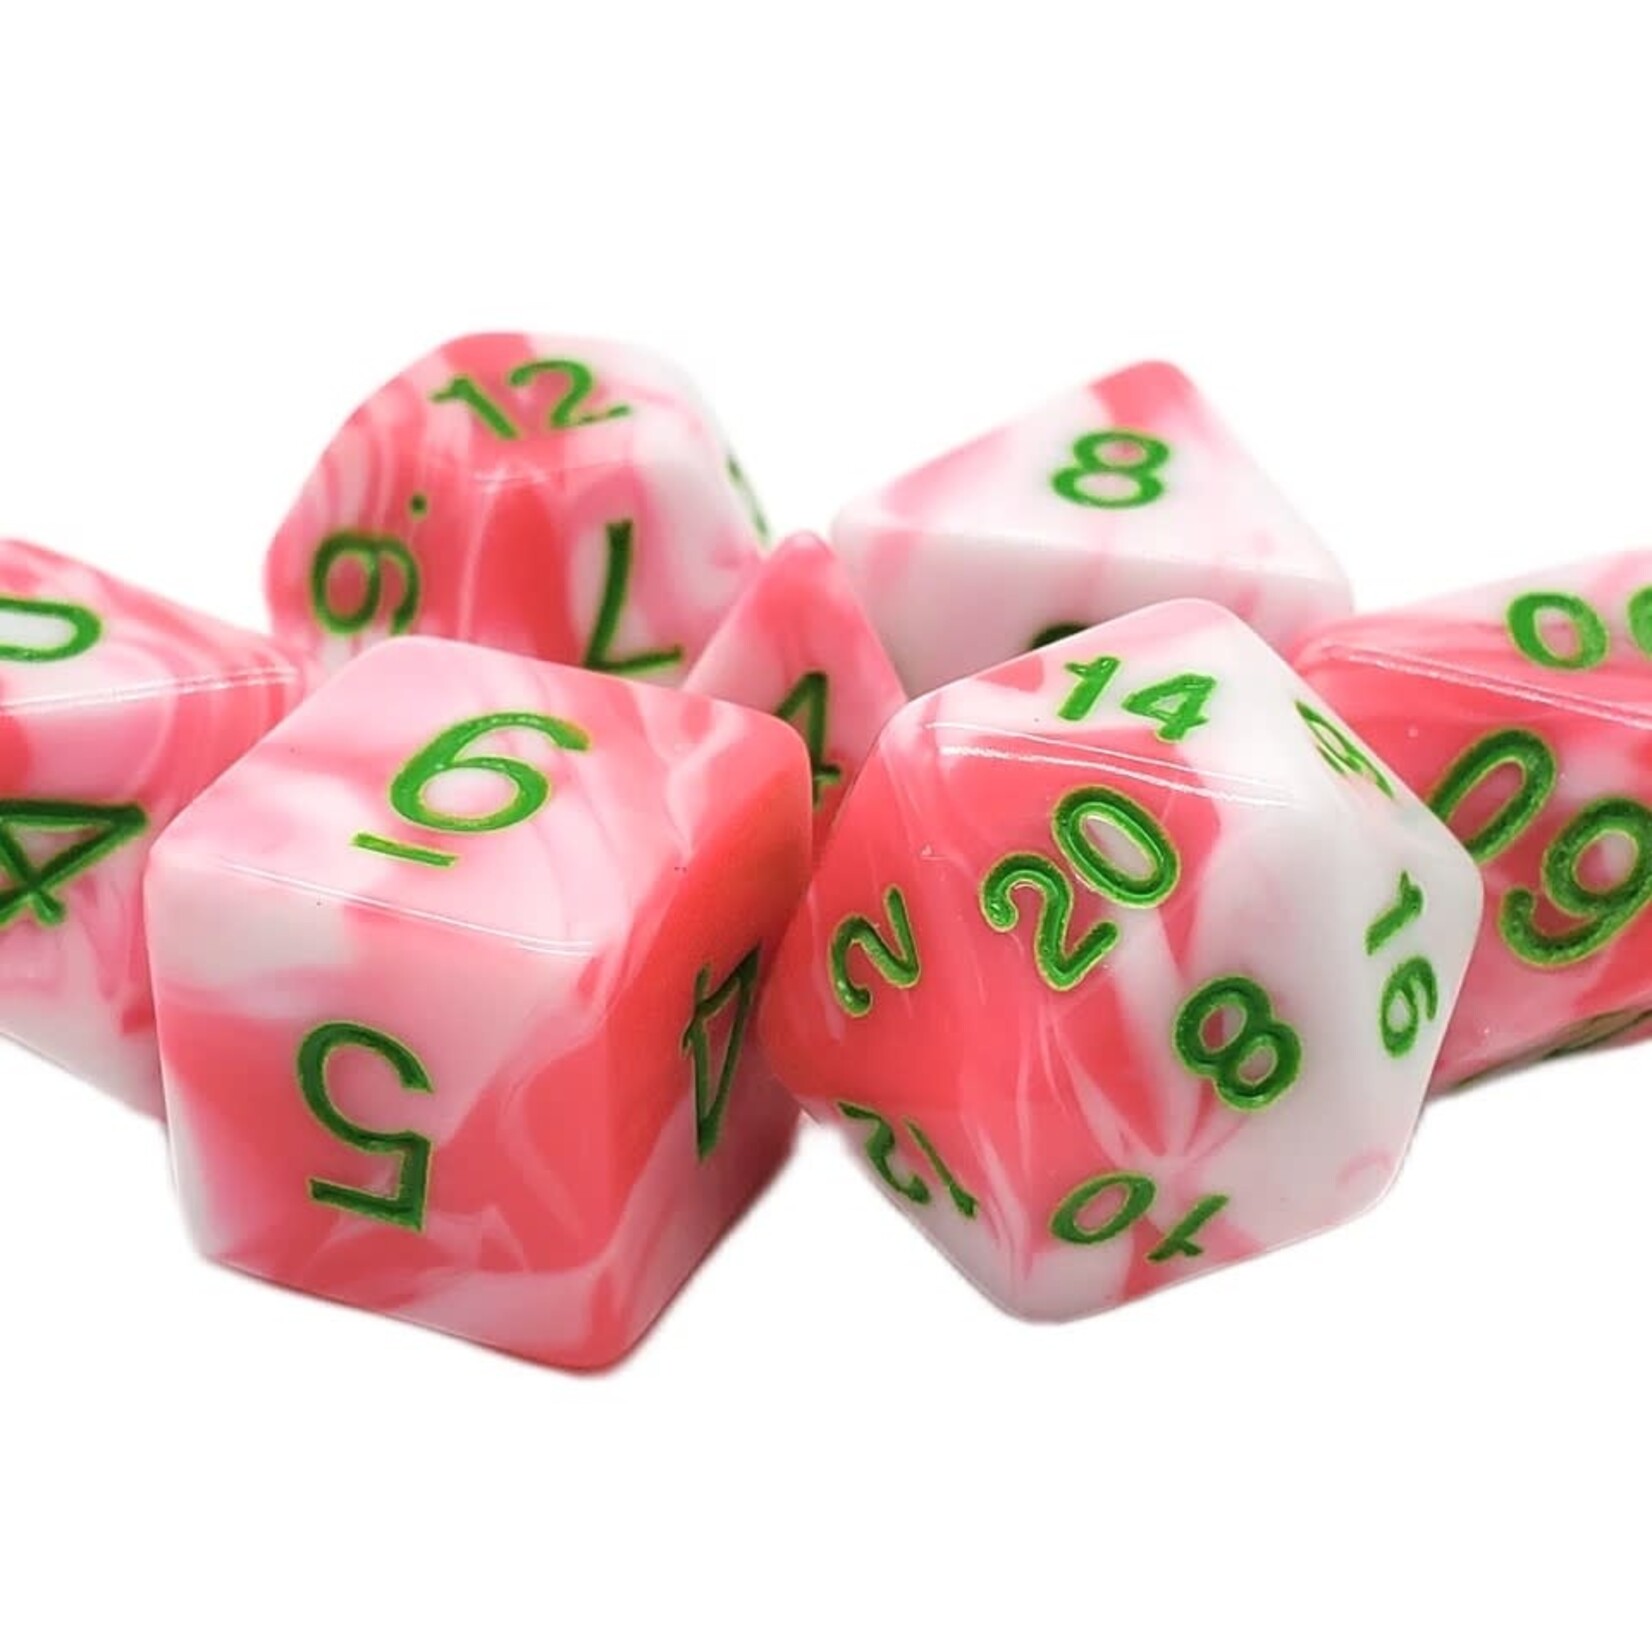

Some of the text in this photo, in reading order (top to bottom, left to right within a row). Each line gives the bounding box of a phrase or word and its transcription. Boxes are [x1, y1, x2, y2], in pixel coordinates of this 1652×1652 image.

[430, 359, 630, 440] 12
[1048, 430, 1176, 511] 8
[1057, 656, 1222, 742] 14
[353, 711, 588, 868] 6
[830, 886, 922, 1018] 2
[983, 787, 1178, 992] 20
[1363, 872, 1441, 1062] 16
[682, 940, 761, 1164] 4
[1174, 975, 1303, 1112] 8
[294, 1022, 434, 1232] 5
[1050, 1172, 1230, 1263] 10
